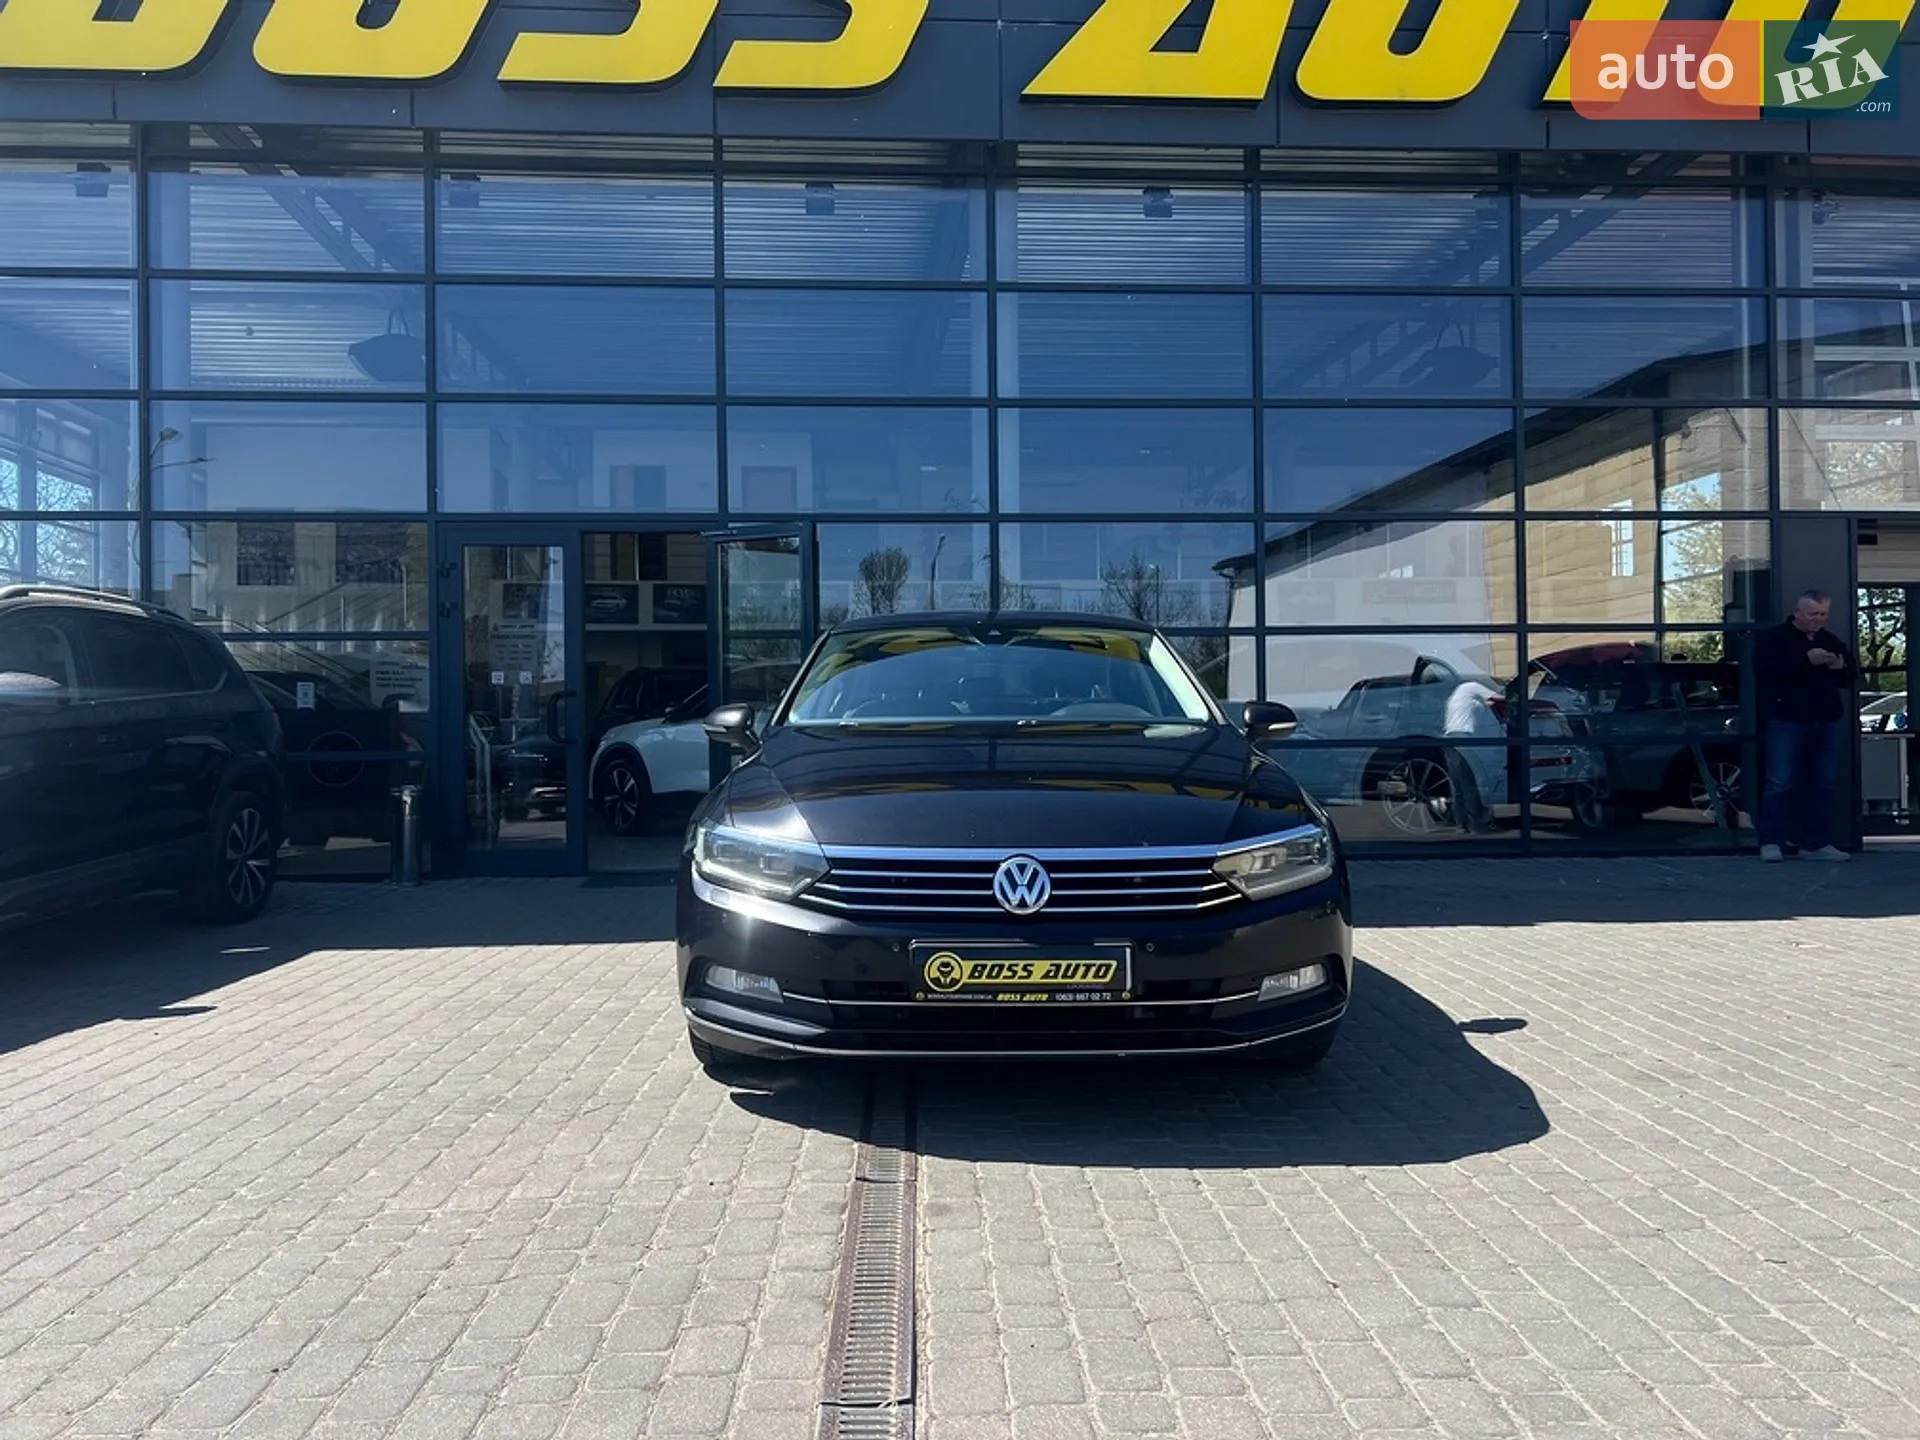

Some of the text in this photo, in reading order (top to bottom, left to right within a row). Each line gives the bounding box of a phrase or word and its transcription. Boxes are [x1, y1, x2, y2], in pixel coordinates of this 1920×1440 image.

[967, 963, 1112, 980] BOSS AUTO
[1022, 993, 1049, 1002] AUTO
